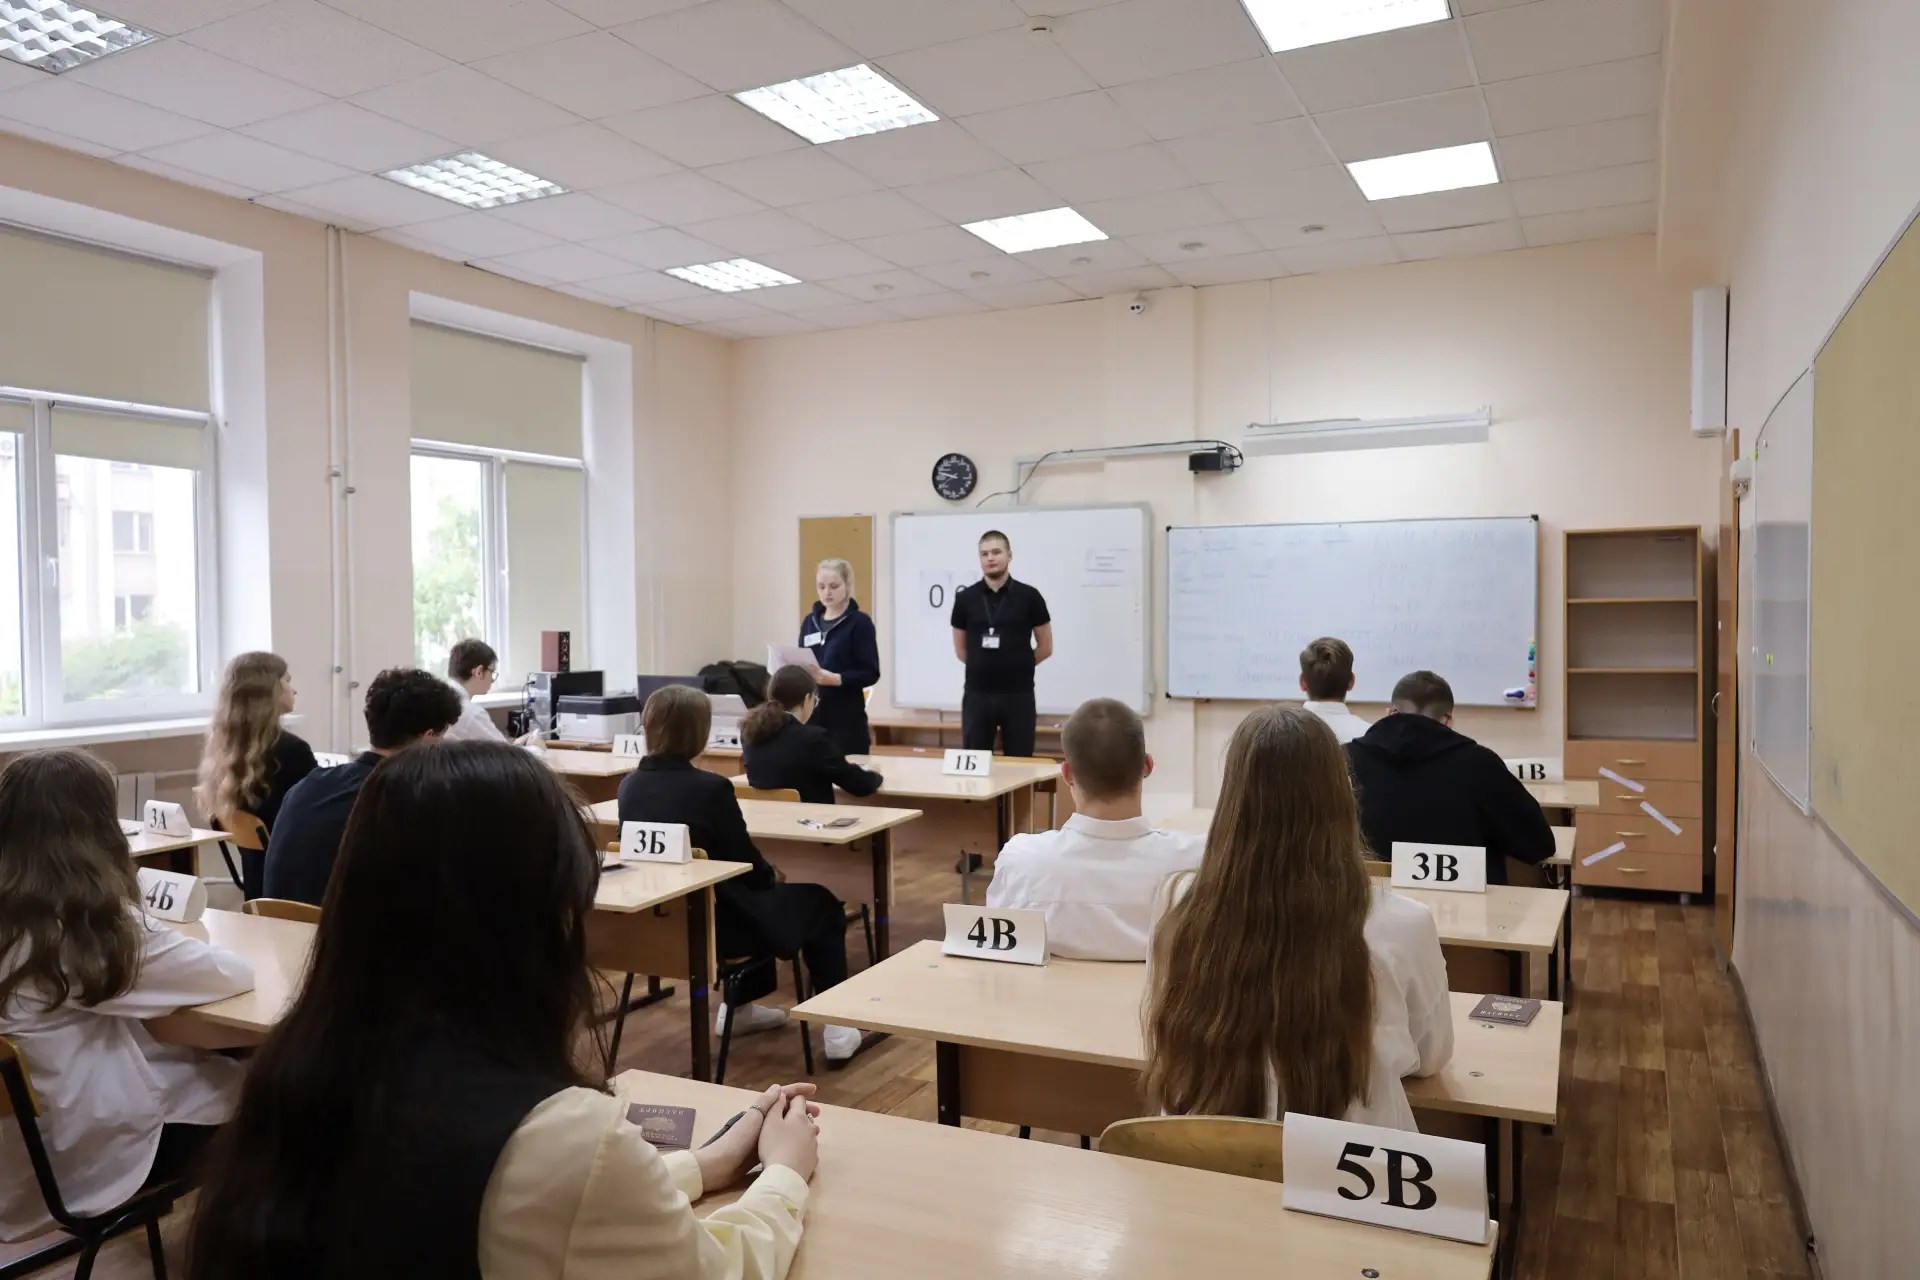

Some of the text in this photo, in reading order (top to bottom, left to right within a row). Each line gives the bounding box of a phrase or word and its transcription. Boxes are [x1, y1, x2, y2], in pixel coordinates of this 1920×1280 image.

[623, 739, 640, 754] 1А
[955, 754, 977, 771] 1Б
[1516, 762, 1547, 781] 1В
[149, 808, 168, 830] 3А
[633, 829, 666, 855] 3Б
[1411, 852, 1459, 882] 3В
[145, 879, 179, 911] 4Б
[967, 916, 1017, 951] 4В
[1336, 1141, 1437, 1210] 5В
